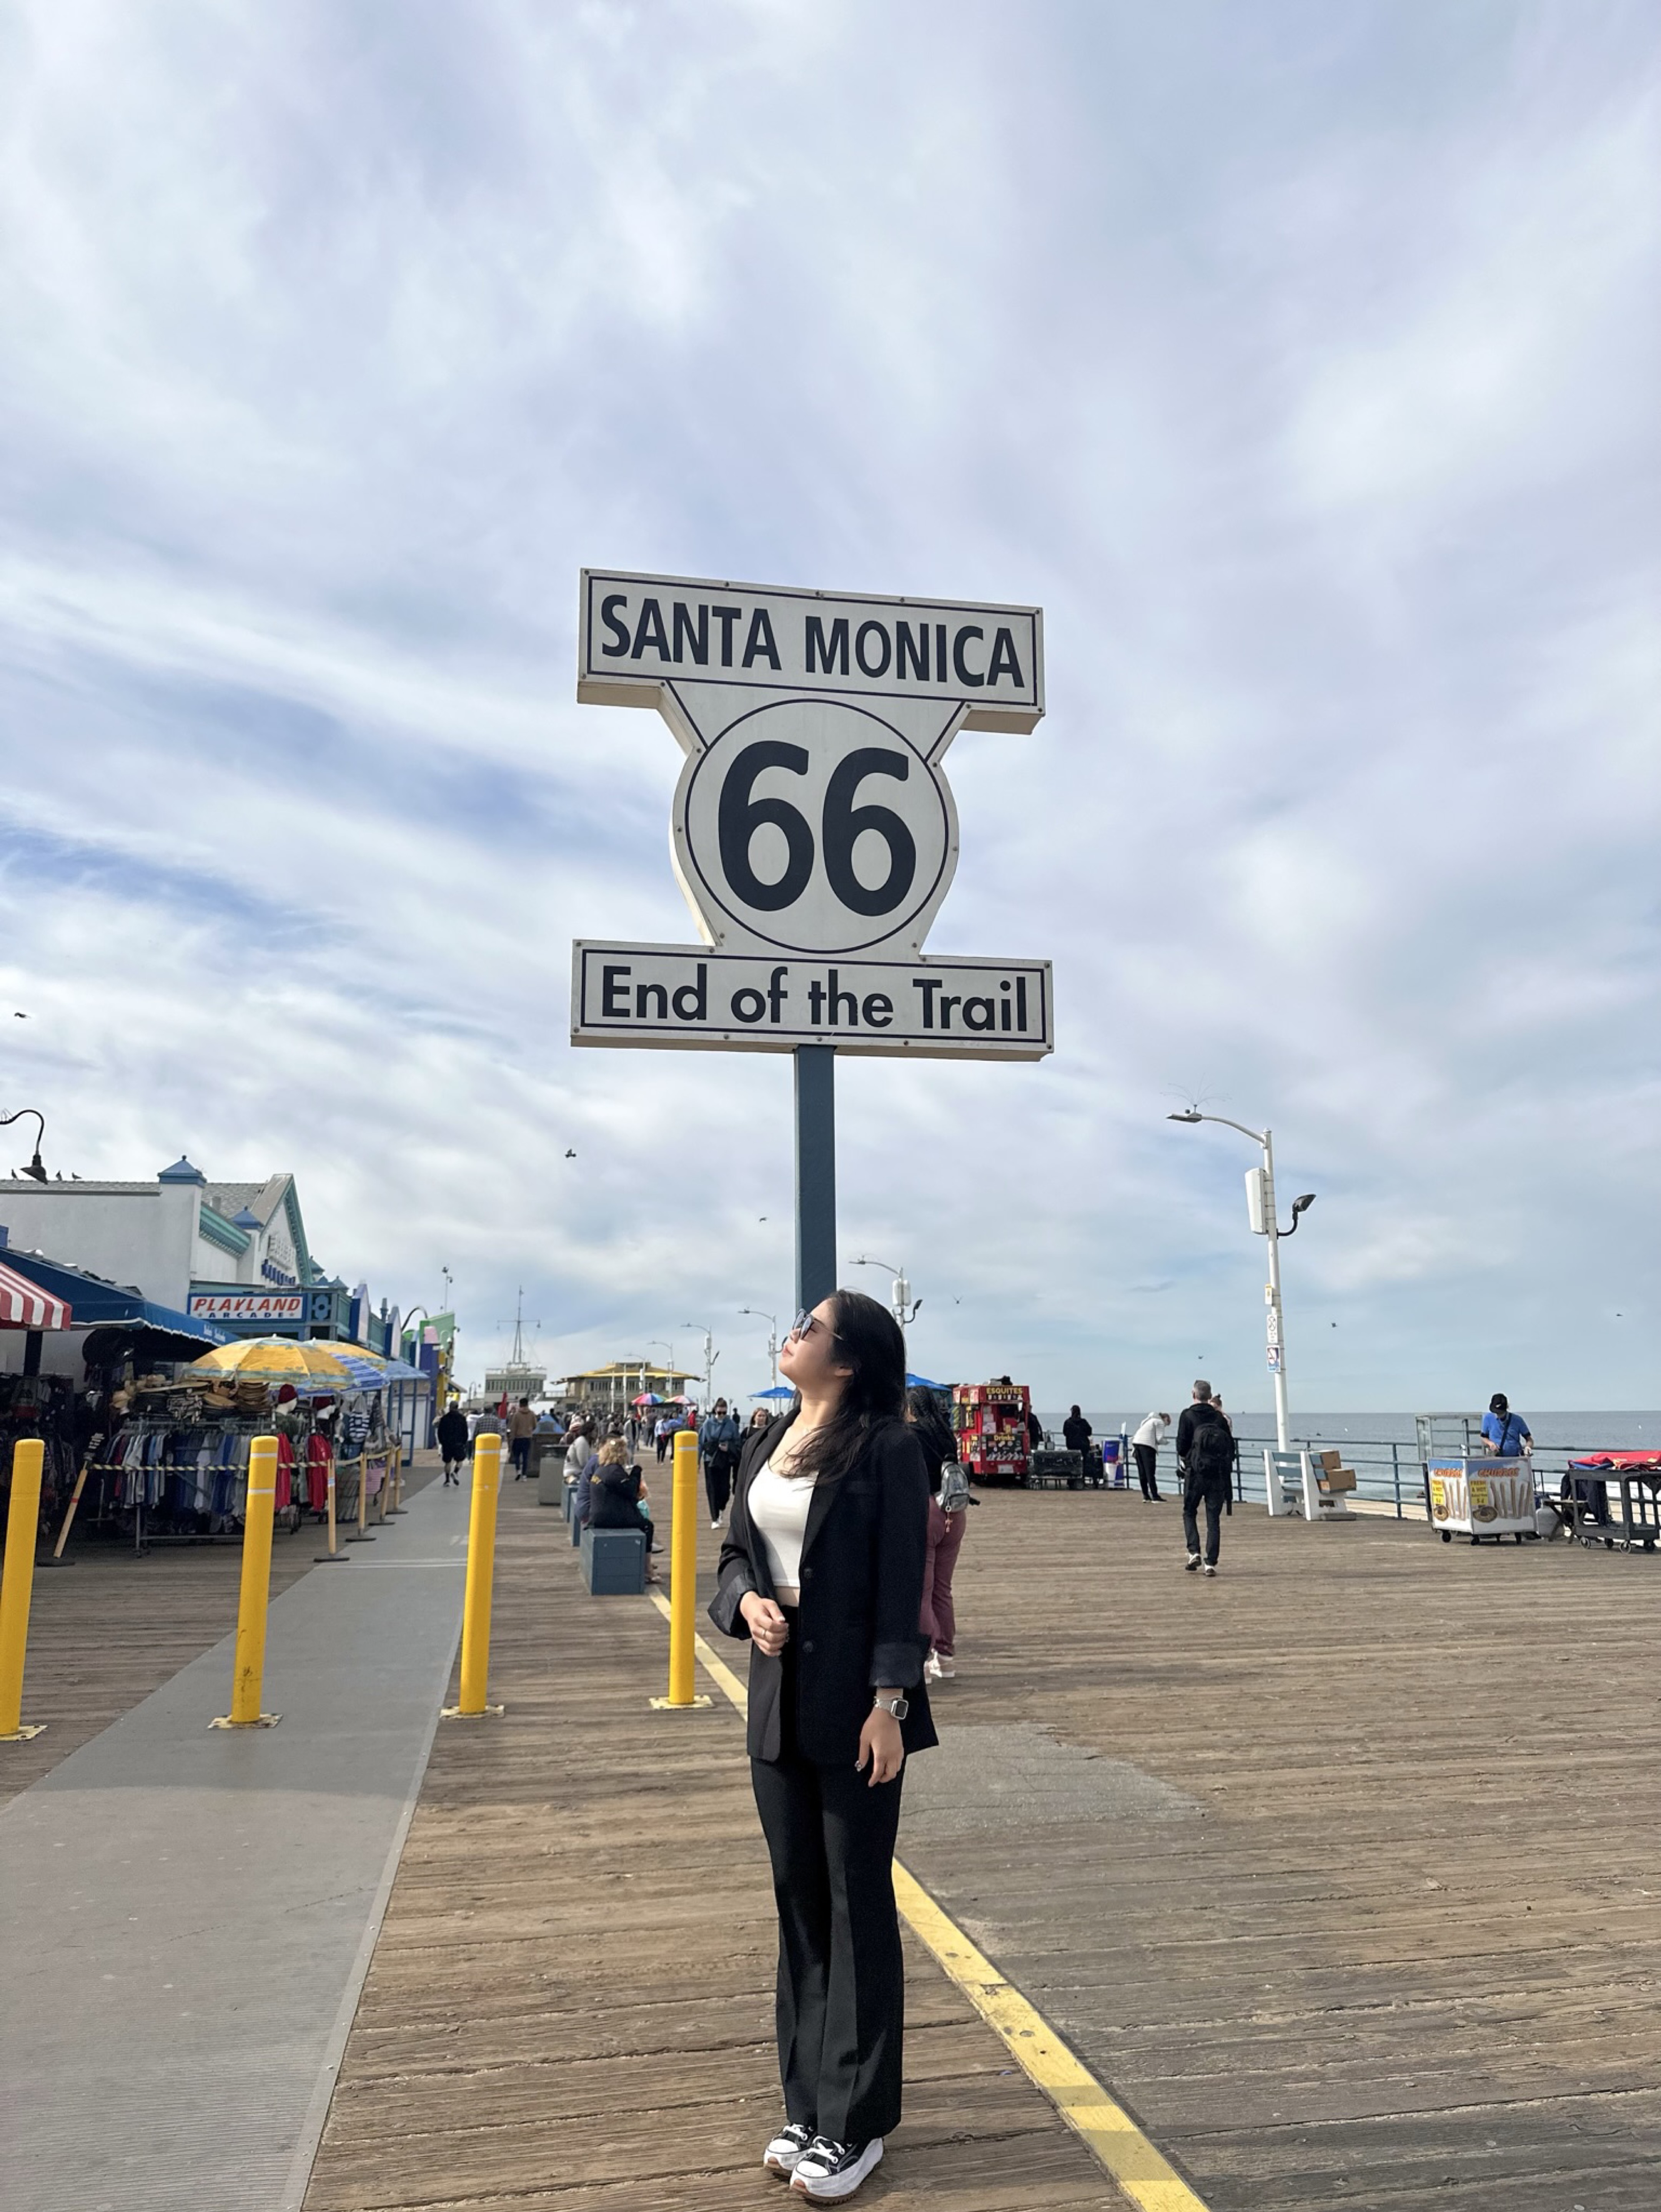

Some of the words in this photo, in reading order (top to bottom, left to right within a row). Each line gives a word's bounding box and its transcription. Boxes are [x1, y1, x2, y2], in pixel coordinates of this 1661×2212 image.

[601, 594, 782, 671] SANTA
[805, 615, 1025, 688] MONICA
[718, 740, 916, 917] 66
[602, 963, 707, 1021] End
[731, 966, 788, 1023] of
[808, 969, 894, 1028] the
[912, 976, 1027, 1032] Trail
[193, 1298, 301, 1311] PLAYLAND
